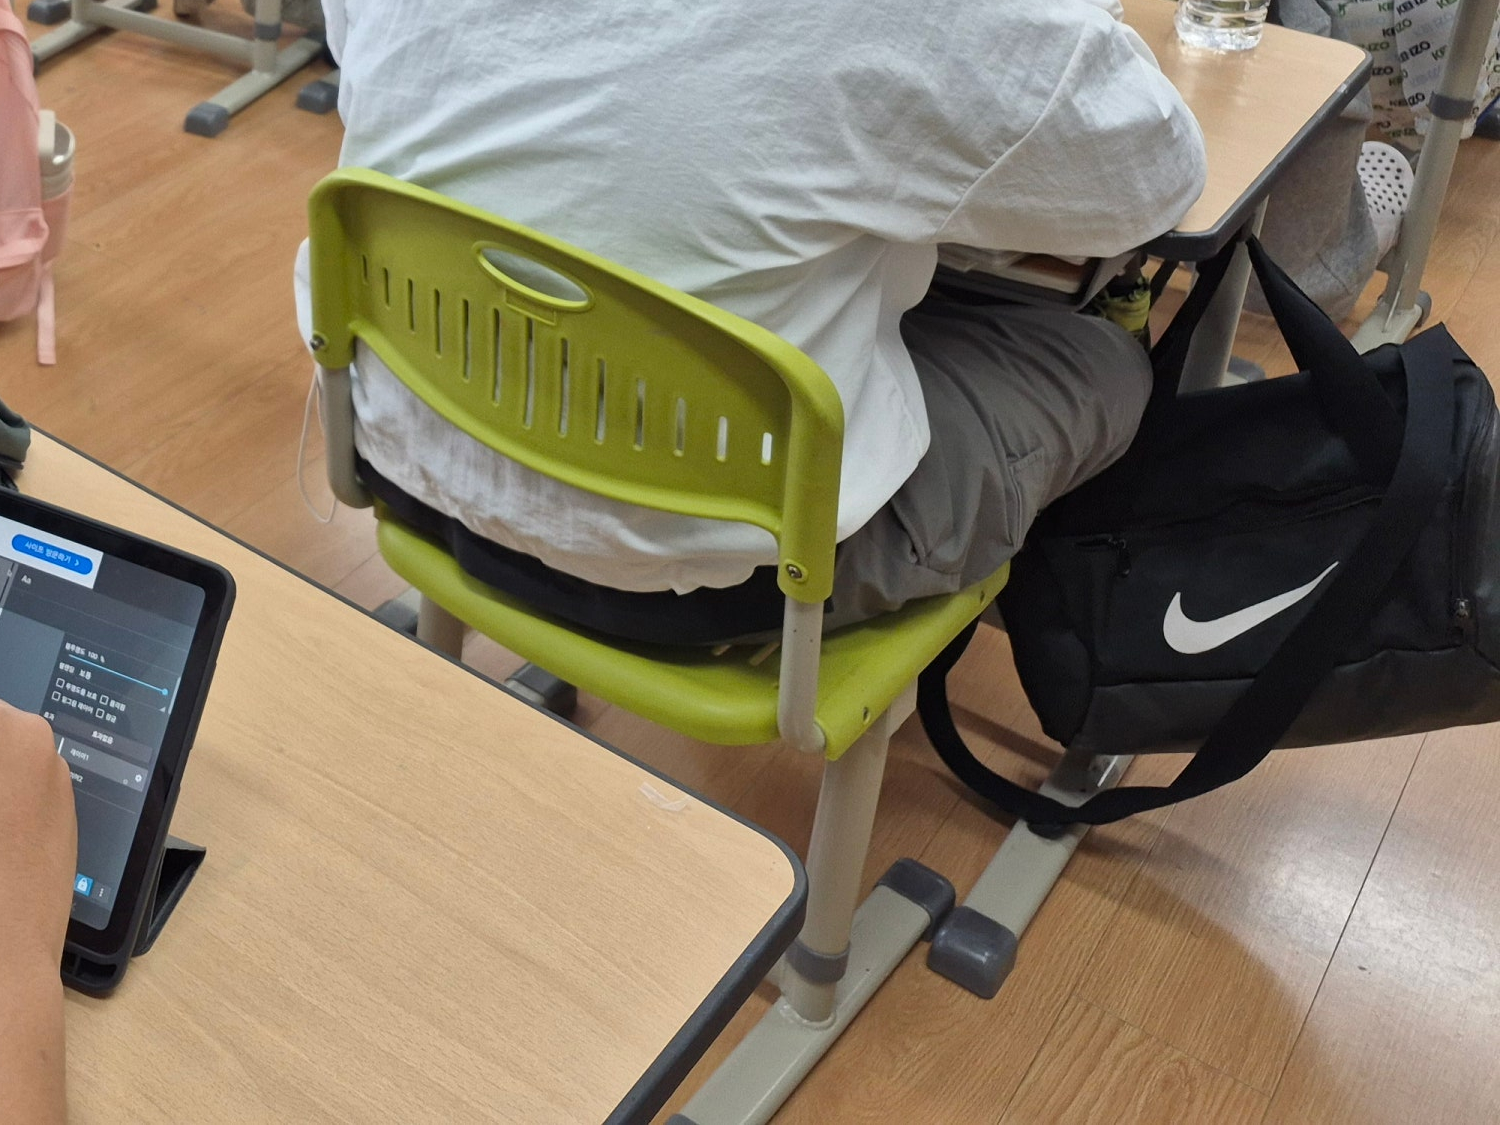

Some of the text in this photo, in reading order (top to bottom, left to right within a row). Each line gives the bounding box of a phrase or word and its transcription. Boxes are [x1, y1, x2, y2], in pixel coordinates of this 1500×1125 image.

[24, 541, 72, 565] 사이트 방문하기
[21, 573, 32, 586] Aa
[65, 642, 86, 656] 불투명도
[88, 651, 99, 660] 100
[69, 771, 85, 784] 이어2
